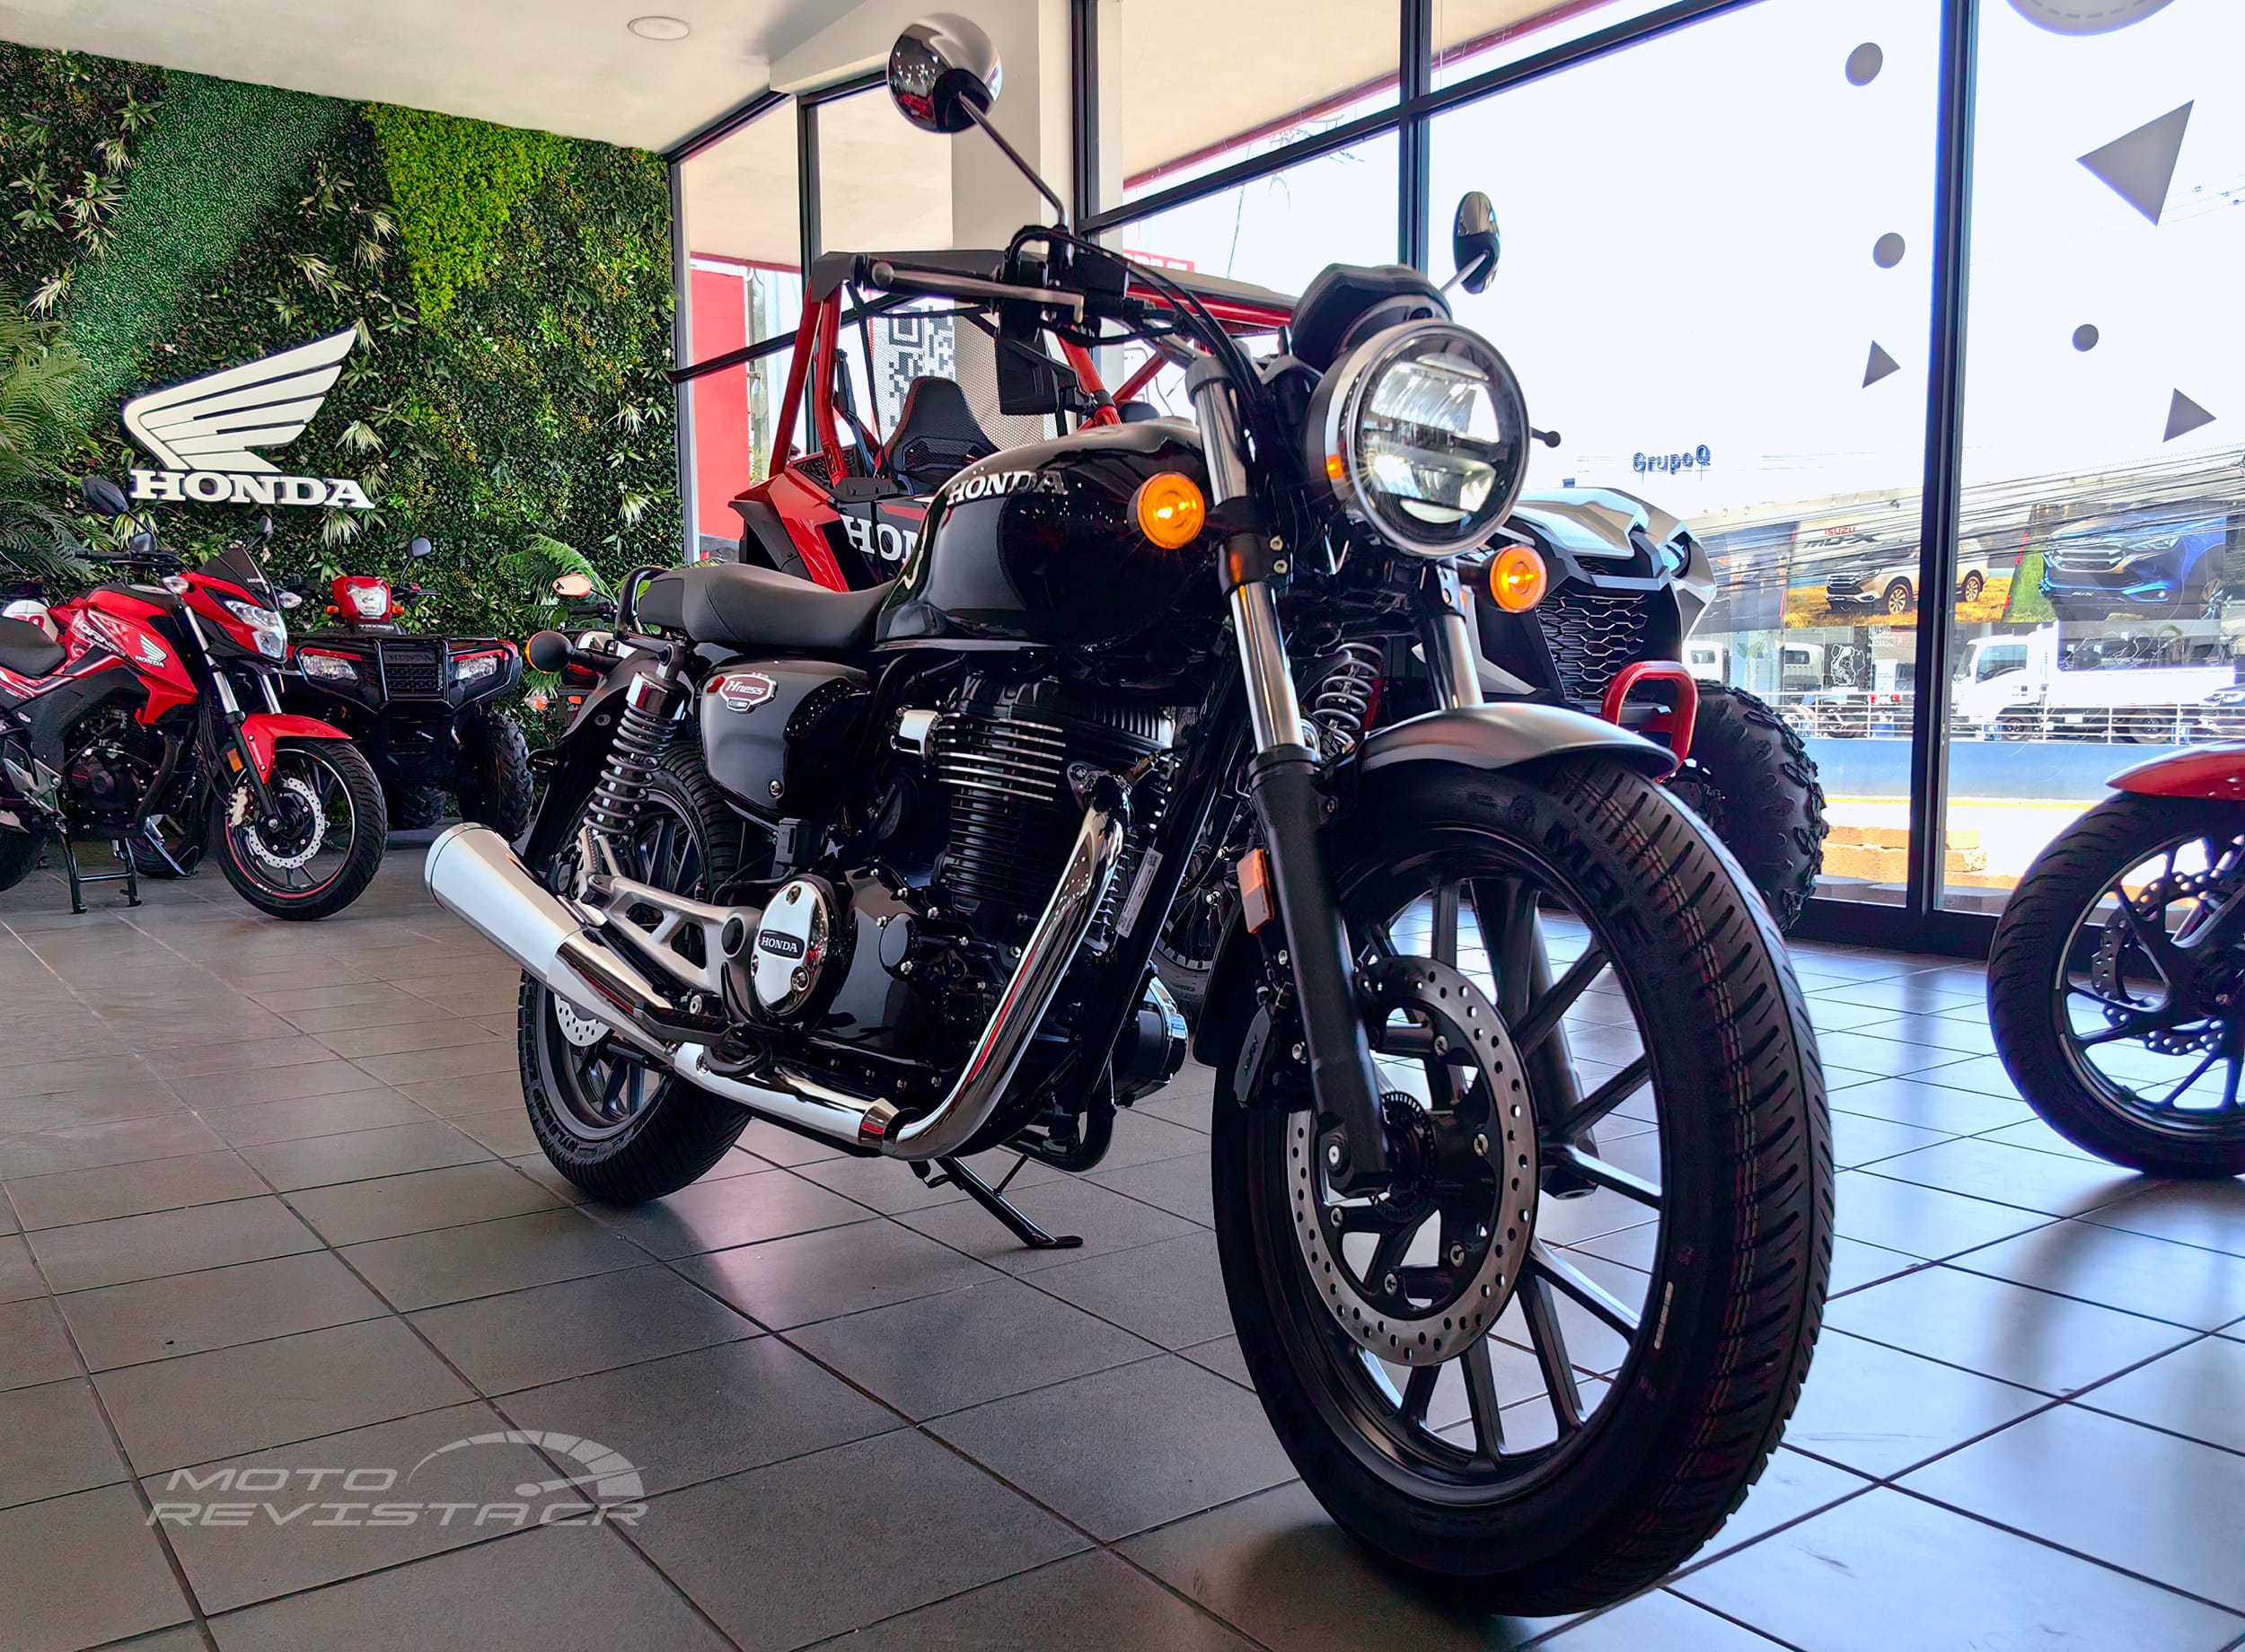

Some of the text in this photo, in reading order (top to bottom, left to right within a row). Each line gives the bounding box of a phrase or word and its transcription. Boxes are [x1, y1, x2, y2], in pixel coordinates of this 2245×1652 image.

[130, 470, 375, 509] HONDA
[946, 470, 1070, 505] HONDA
[1824, 525, 1856, 536] ISUZU
[135, 655, 165, 668] HONDA
[761, 936, 798, 953] HONDA
